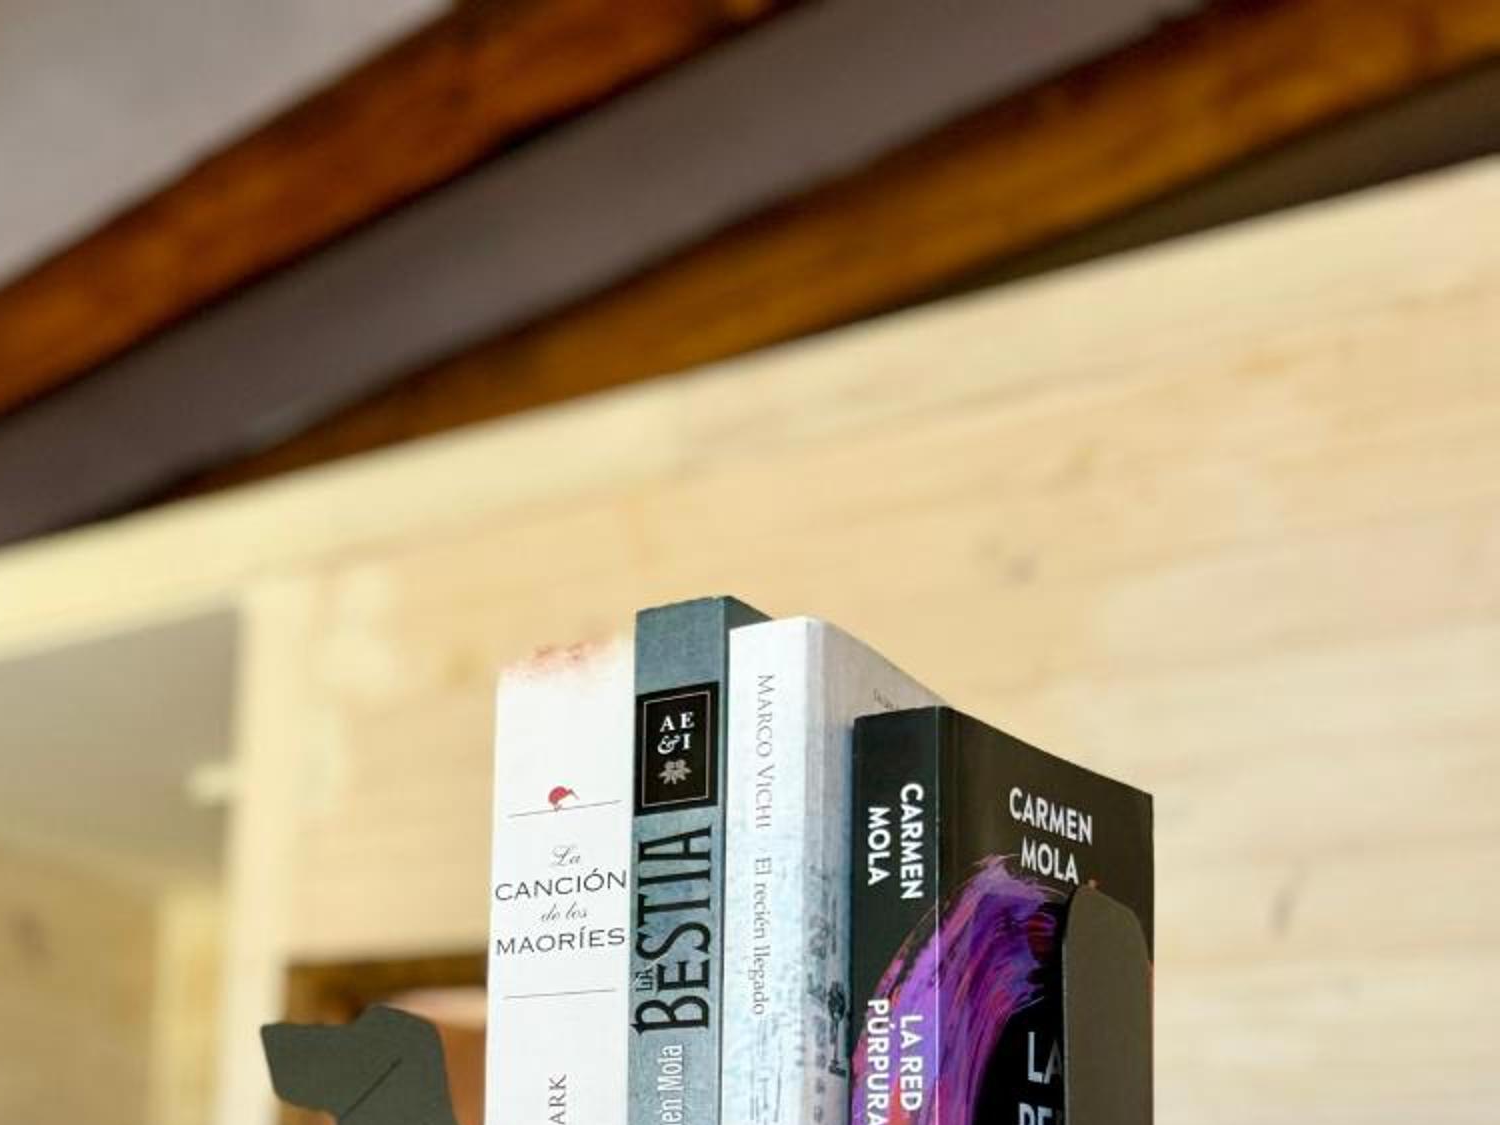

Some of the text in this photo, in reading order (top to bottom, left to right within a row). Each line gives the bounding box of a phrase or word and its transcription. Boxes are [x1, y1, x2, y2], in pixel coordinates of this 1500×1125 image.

[755, 673, 775, 830] MARCO VICHI
[900, 783, 924, 900] CARMEN
[1009, 787, 1093, 845] CARMEN
[550, 844, 581, 867] La
[867, 806, 891, 886] MOLA
[1020, 836, 1079, 885] MOLA
[495, 868, 627, 901] CANCIÓN
[541, 901, 588, 923] de los
[496, 926, 626, 956] MAORÍES
[630, 825, 711, 1036] BESTIA
[748, 857, 772, 1015] El recién llegado
[657, 1044, 683, 1091] Mola
[900, 1015, 924, 1112] LA RED
